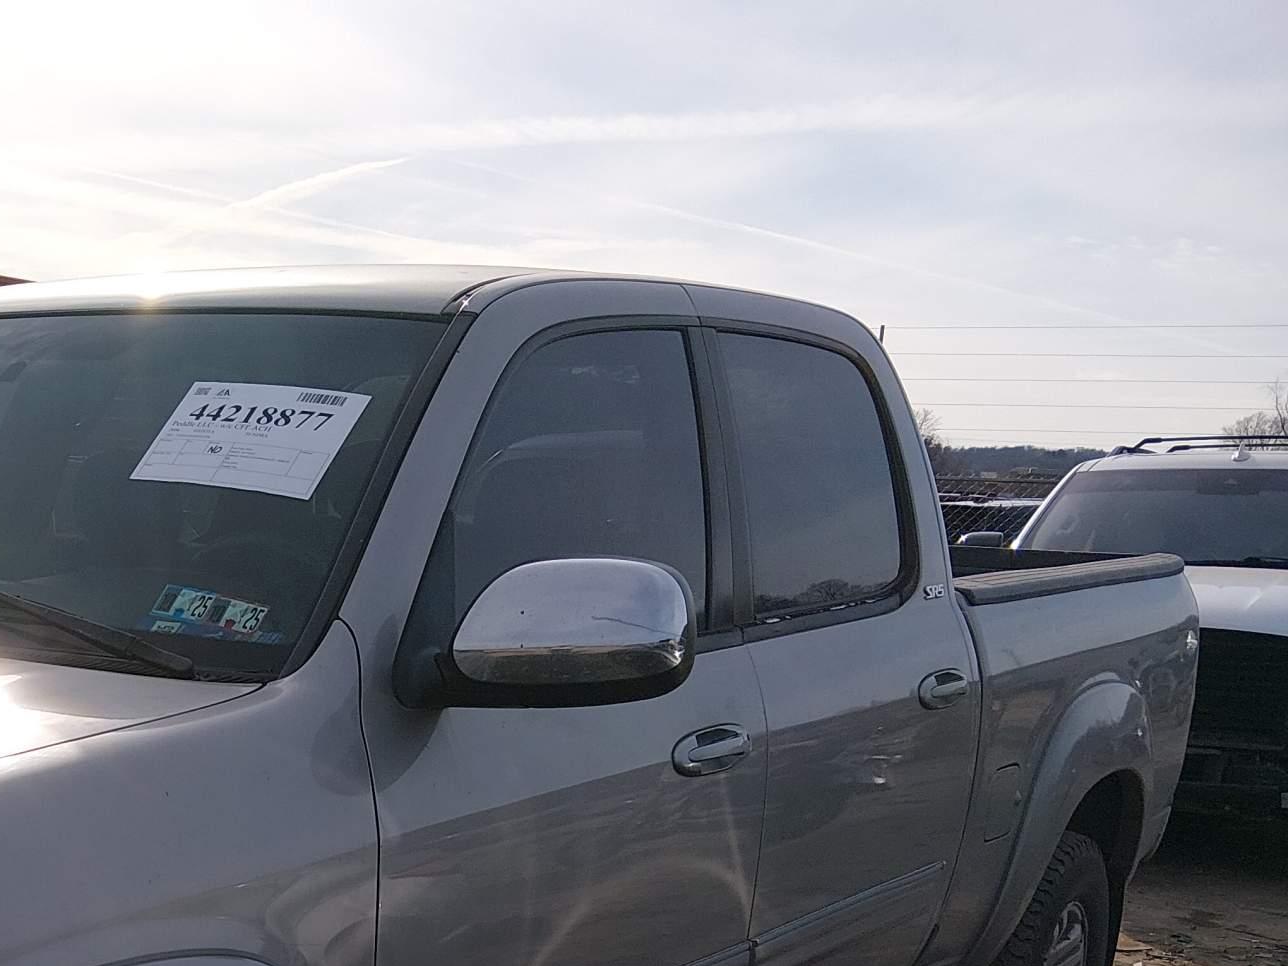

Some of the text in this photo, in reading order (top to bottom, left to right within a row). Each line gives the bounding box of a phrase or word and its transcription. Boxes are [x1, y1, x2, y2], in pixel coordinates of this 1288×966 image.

[189, 403, 335, 431] 44218877
[924, 583, 945, 600] SR5
[190, 595, 213, 618] 25
[241, 607, 265, 631] 25
